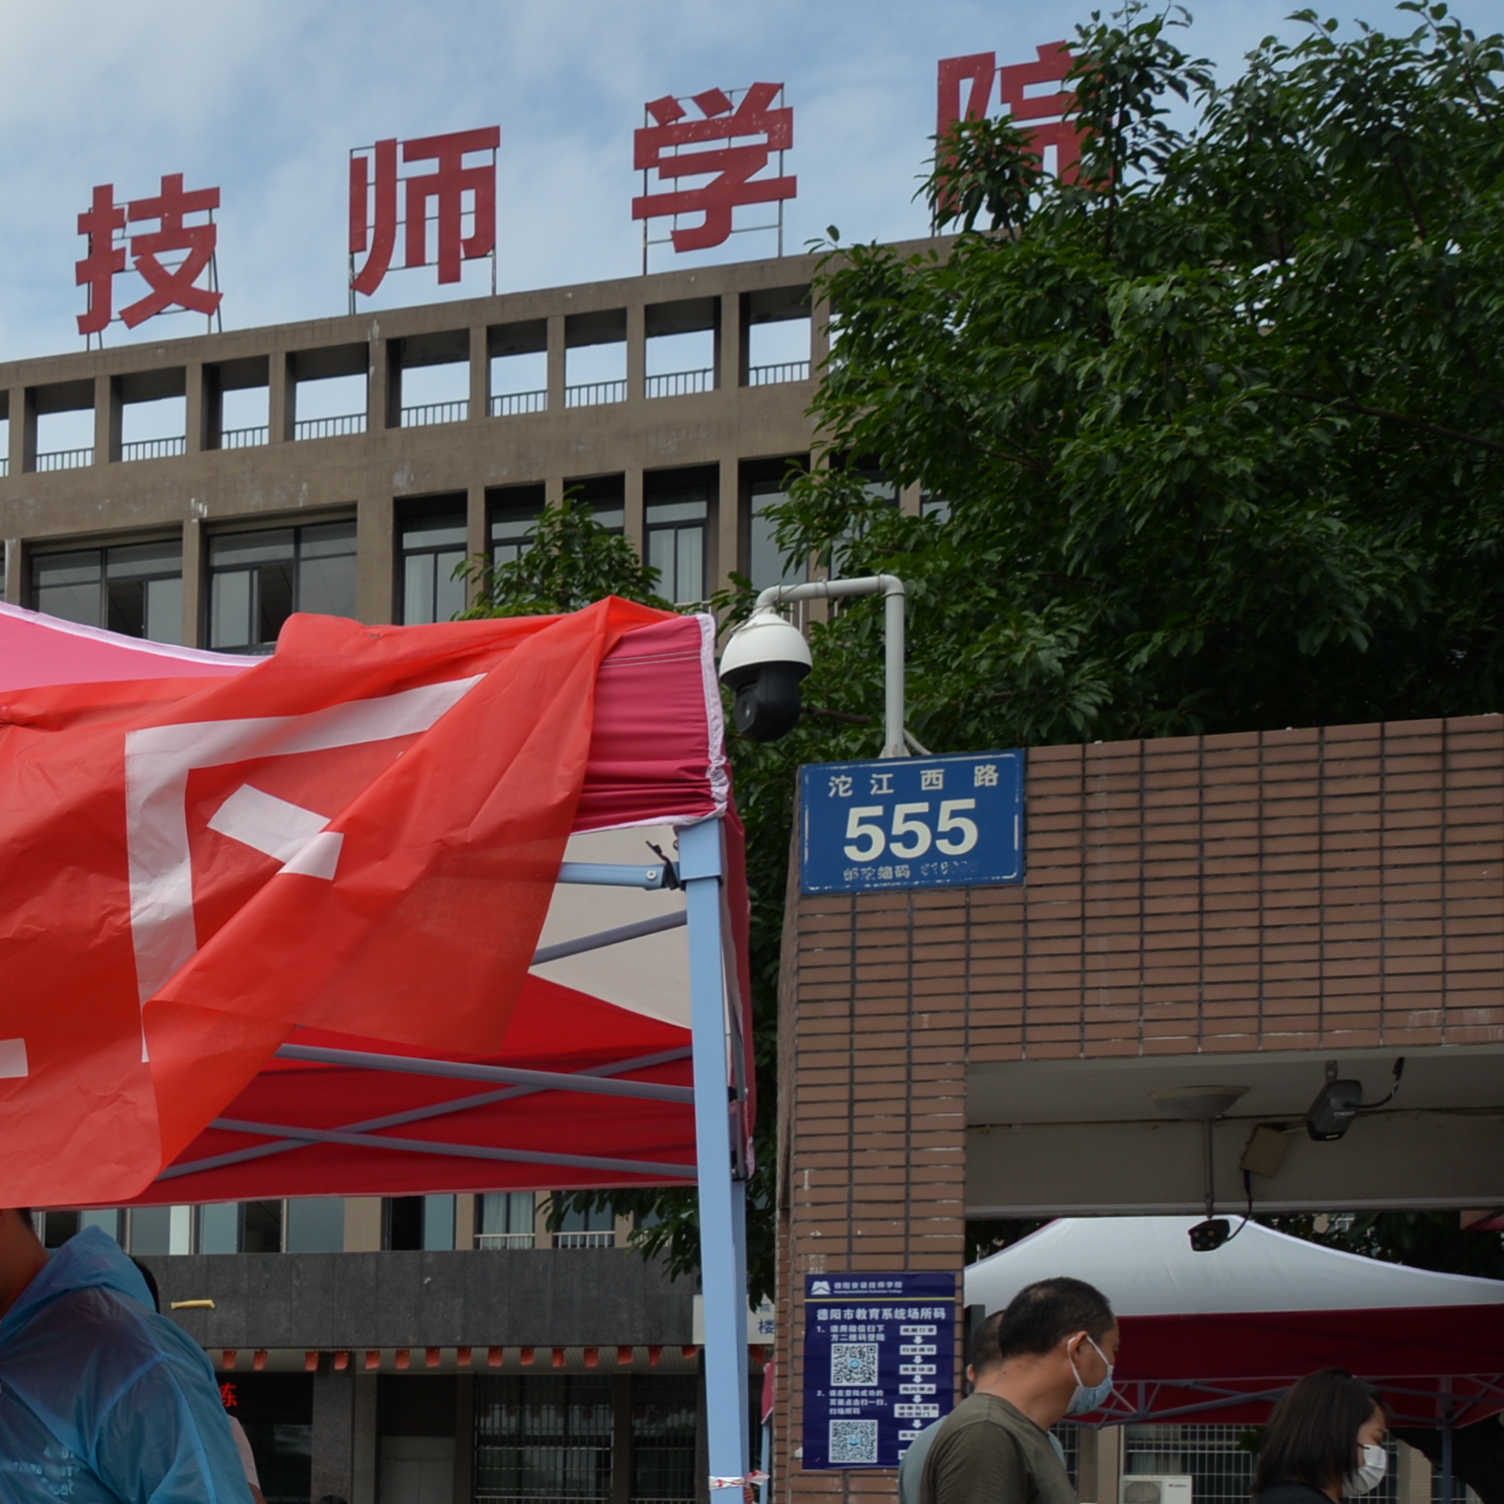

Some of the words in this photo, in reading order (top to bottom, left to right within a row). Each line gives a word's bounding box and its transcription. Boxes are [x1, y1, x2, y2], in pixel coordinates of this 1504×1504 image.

[828, 764, 1000, 798] 沱江西路
[843, 798, 979, 862] 555
[817, 1307, 946, 1321] 德阳市教育系统场所码
